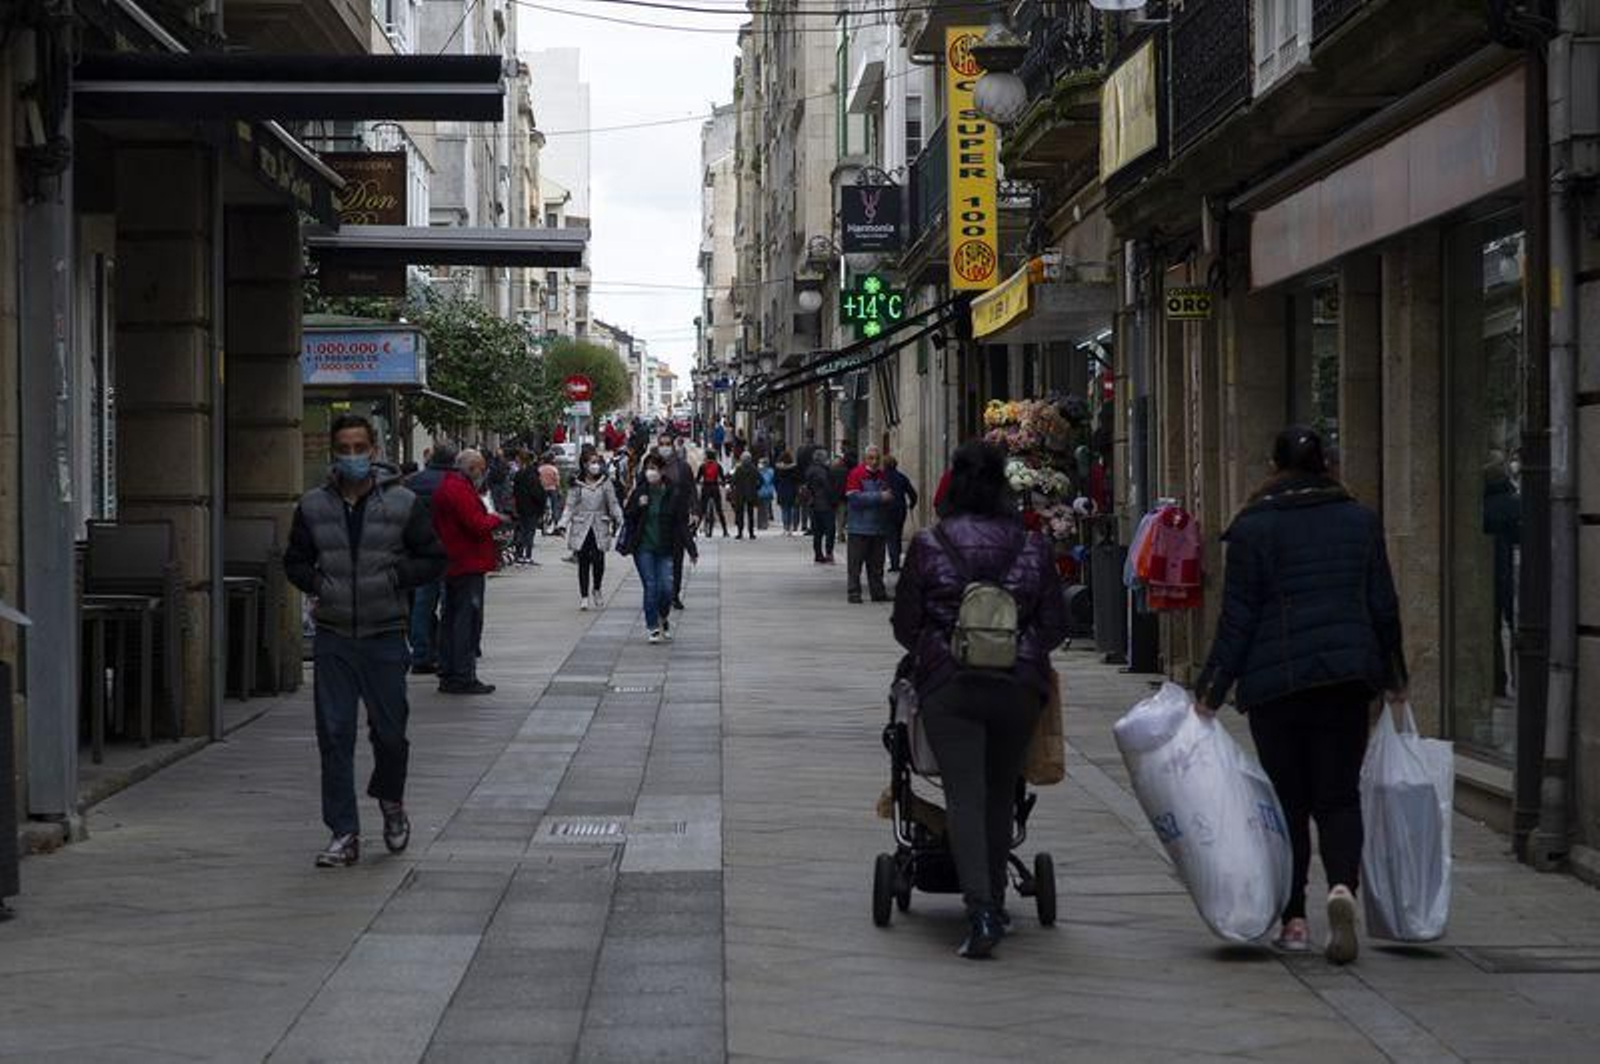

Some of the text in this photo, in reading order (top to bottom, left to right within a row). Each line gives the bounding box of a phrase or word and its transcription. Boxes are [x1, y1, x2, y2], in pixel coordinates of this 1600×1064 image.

[957, 110, 988, 178] SUPER
[341, 179, 399, 211] Don
[961, 196, 986, 236] 100
[1168, 299, 1210, 311] ORO
